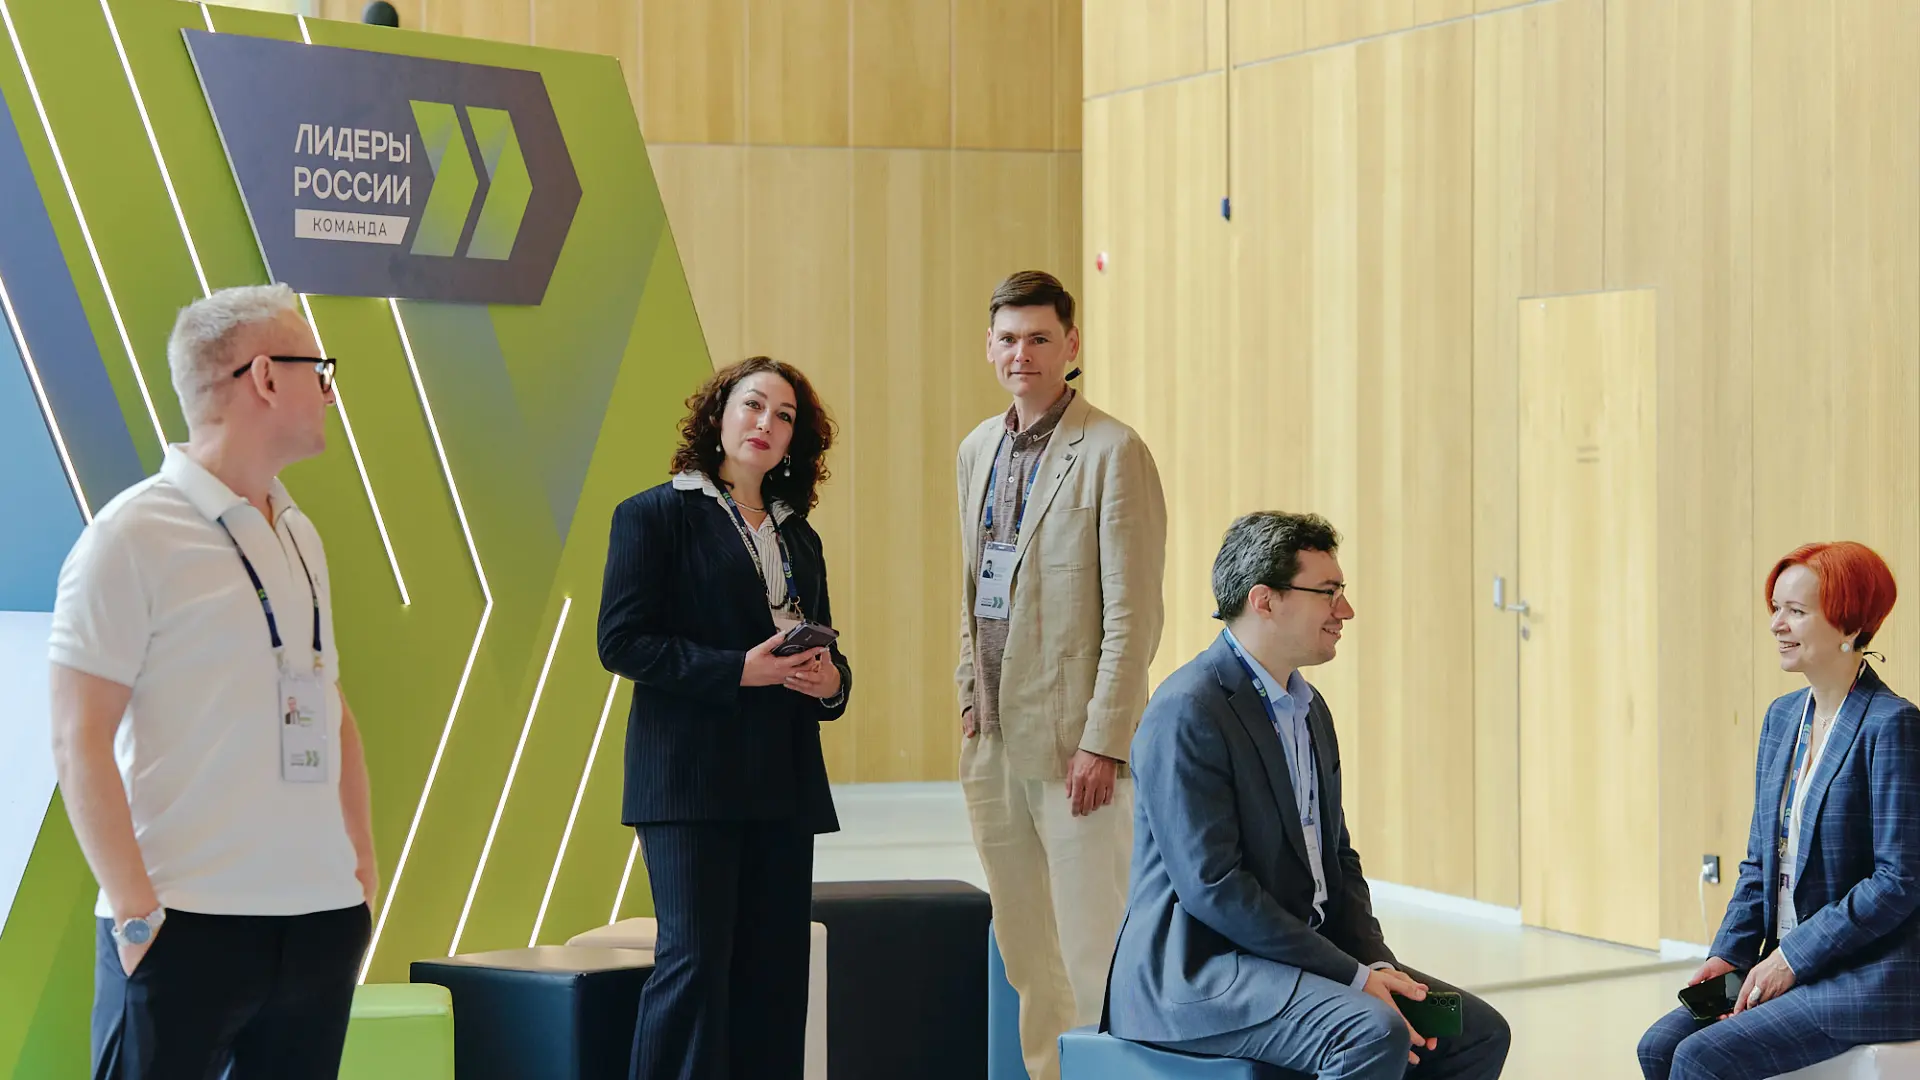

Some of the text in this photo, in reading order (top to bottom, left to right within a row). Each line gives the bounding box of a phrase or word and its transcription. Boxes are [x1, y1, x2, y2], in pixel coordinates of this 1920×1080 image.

[294, 123, 411, 163] ЛИДЕРЫ
[294, 166, 411, 205] РОССИИ
[313, 217, 388, 237] КОМАНДА
